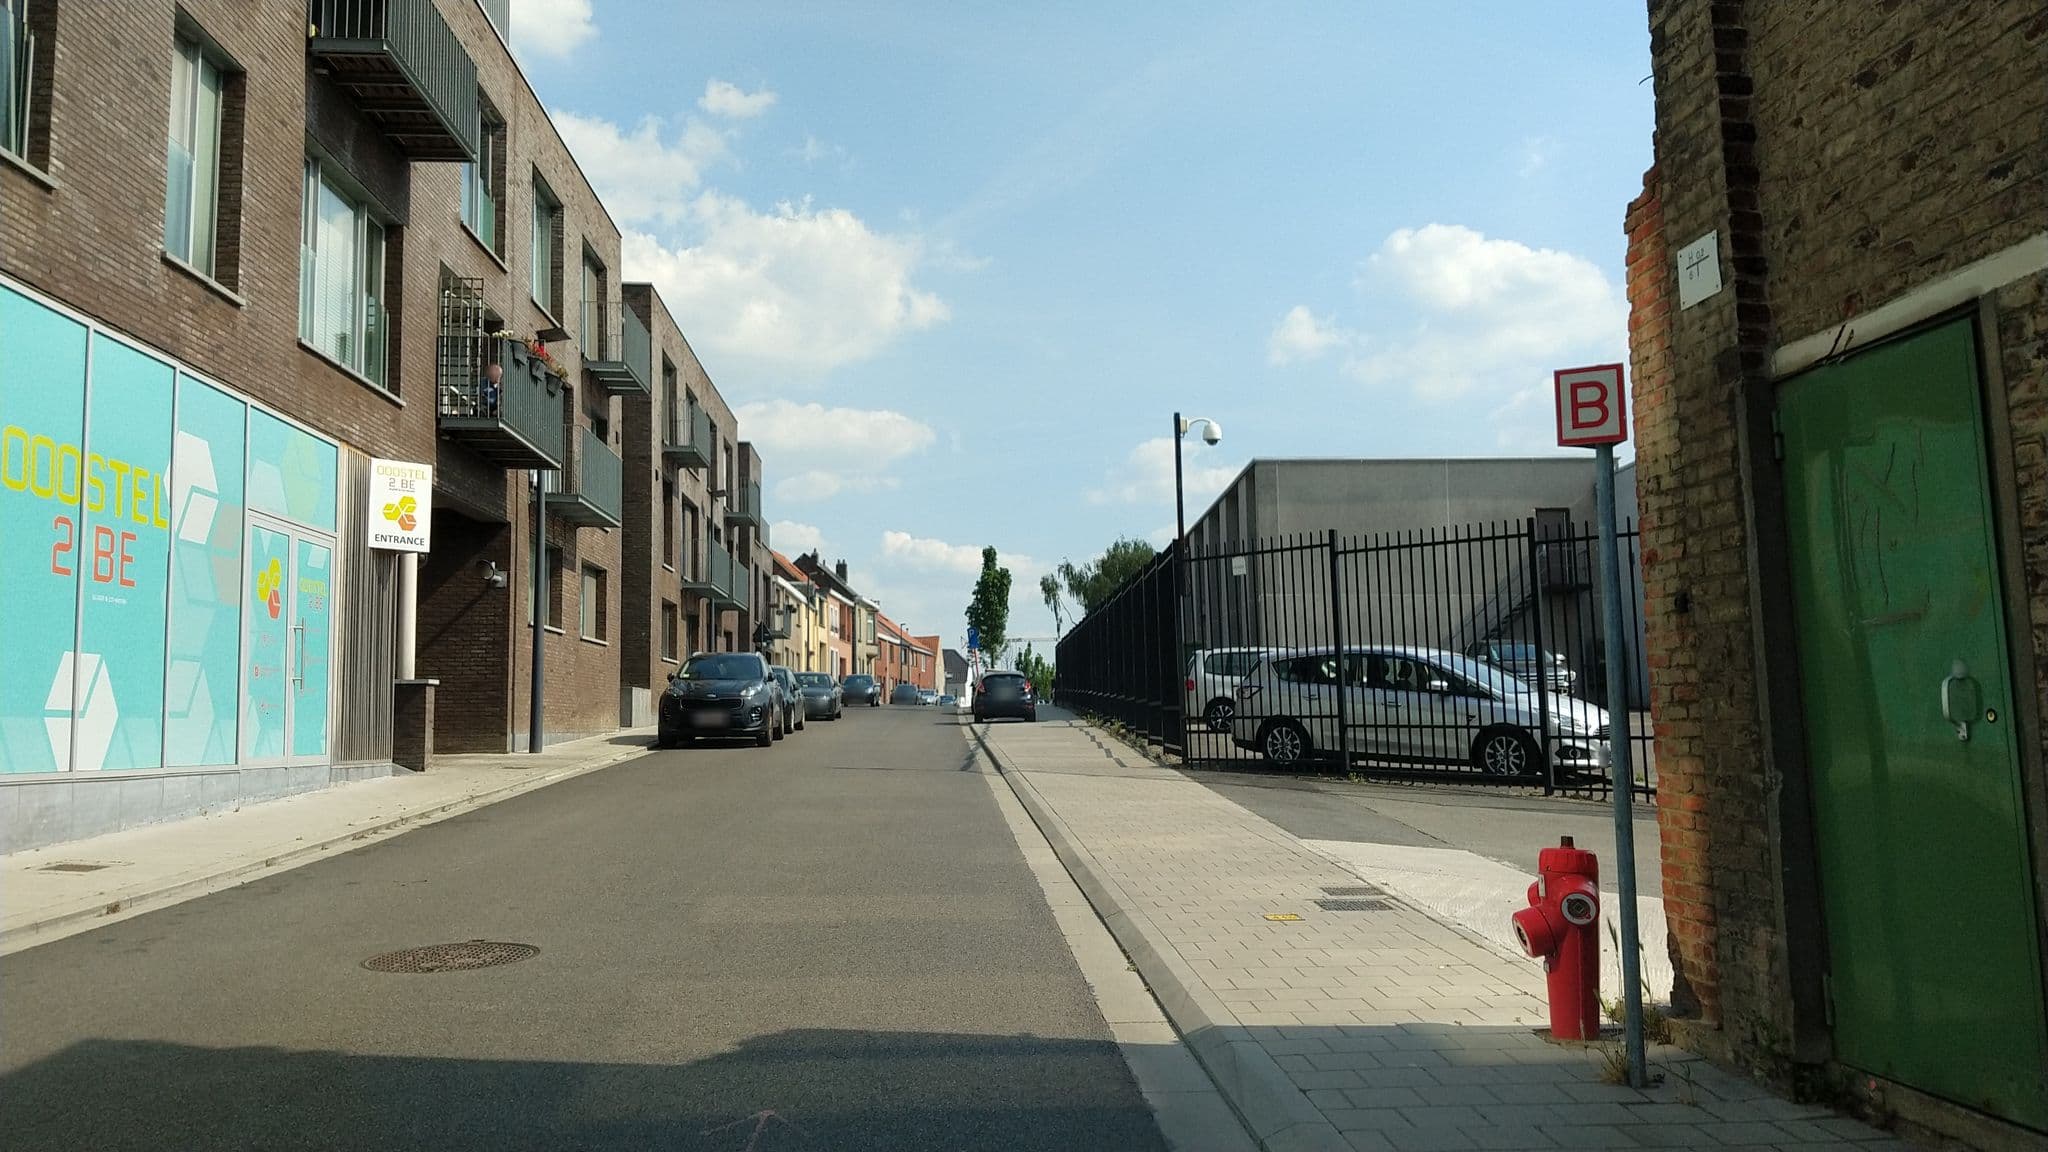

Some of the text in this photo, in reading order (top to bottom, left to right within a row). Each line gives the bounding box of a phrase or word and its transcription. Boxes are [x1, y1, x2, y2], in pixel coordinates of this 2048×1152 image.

[1570, 381, 1609, 430] B
[2, 425, 169, 529] OOOSTEL
[388, 477, 416, 490] 2 BE
[52, 516, 137, 587] 2 BE
[374, 533, 425, 546] ENTRANCE
